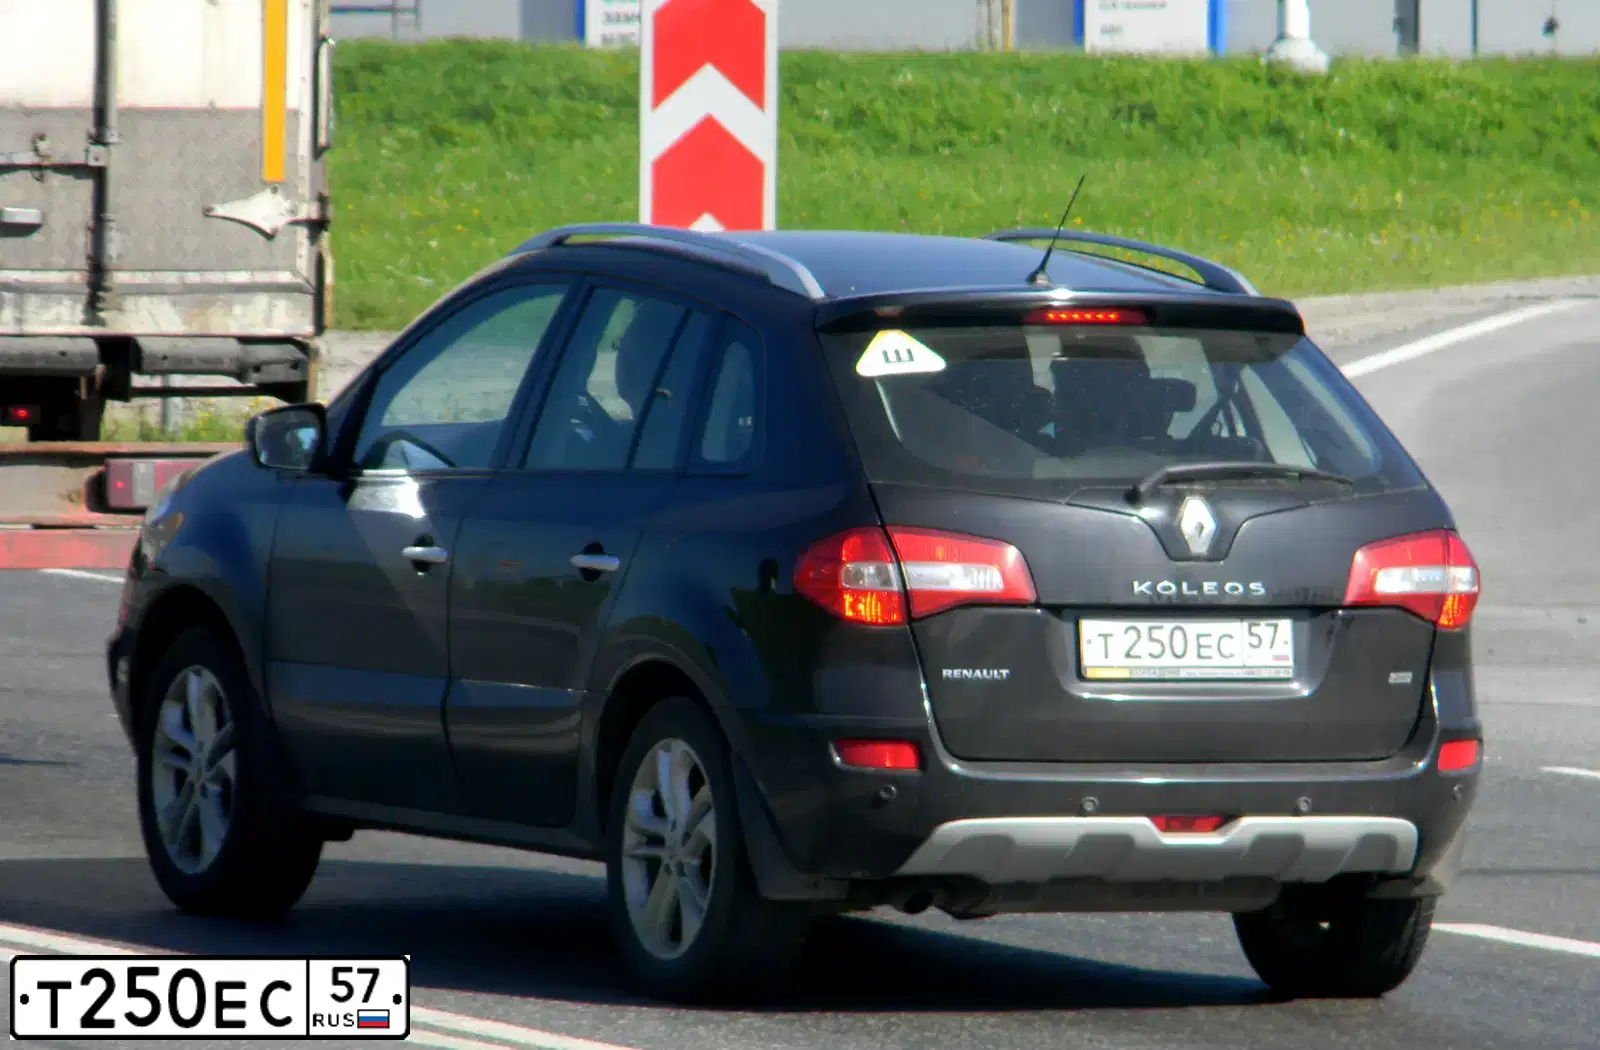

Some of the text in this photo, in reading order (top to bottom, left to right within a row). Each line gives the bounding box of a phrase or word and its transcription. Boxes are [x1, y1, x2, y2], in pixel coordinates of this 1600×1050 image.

[1133, 580, 1266, 596] KOLEOS
[1247, 622, 1279, 649] 57
[942, 668, 1010, 680] RENAULT
